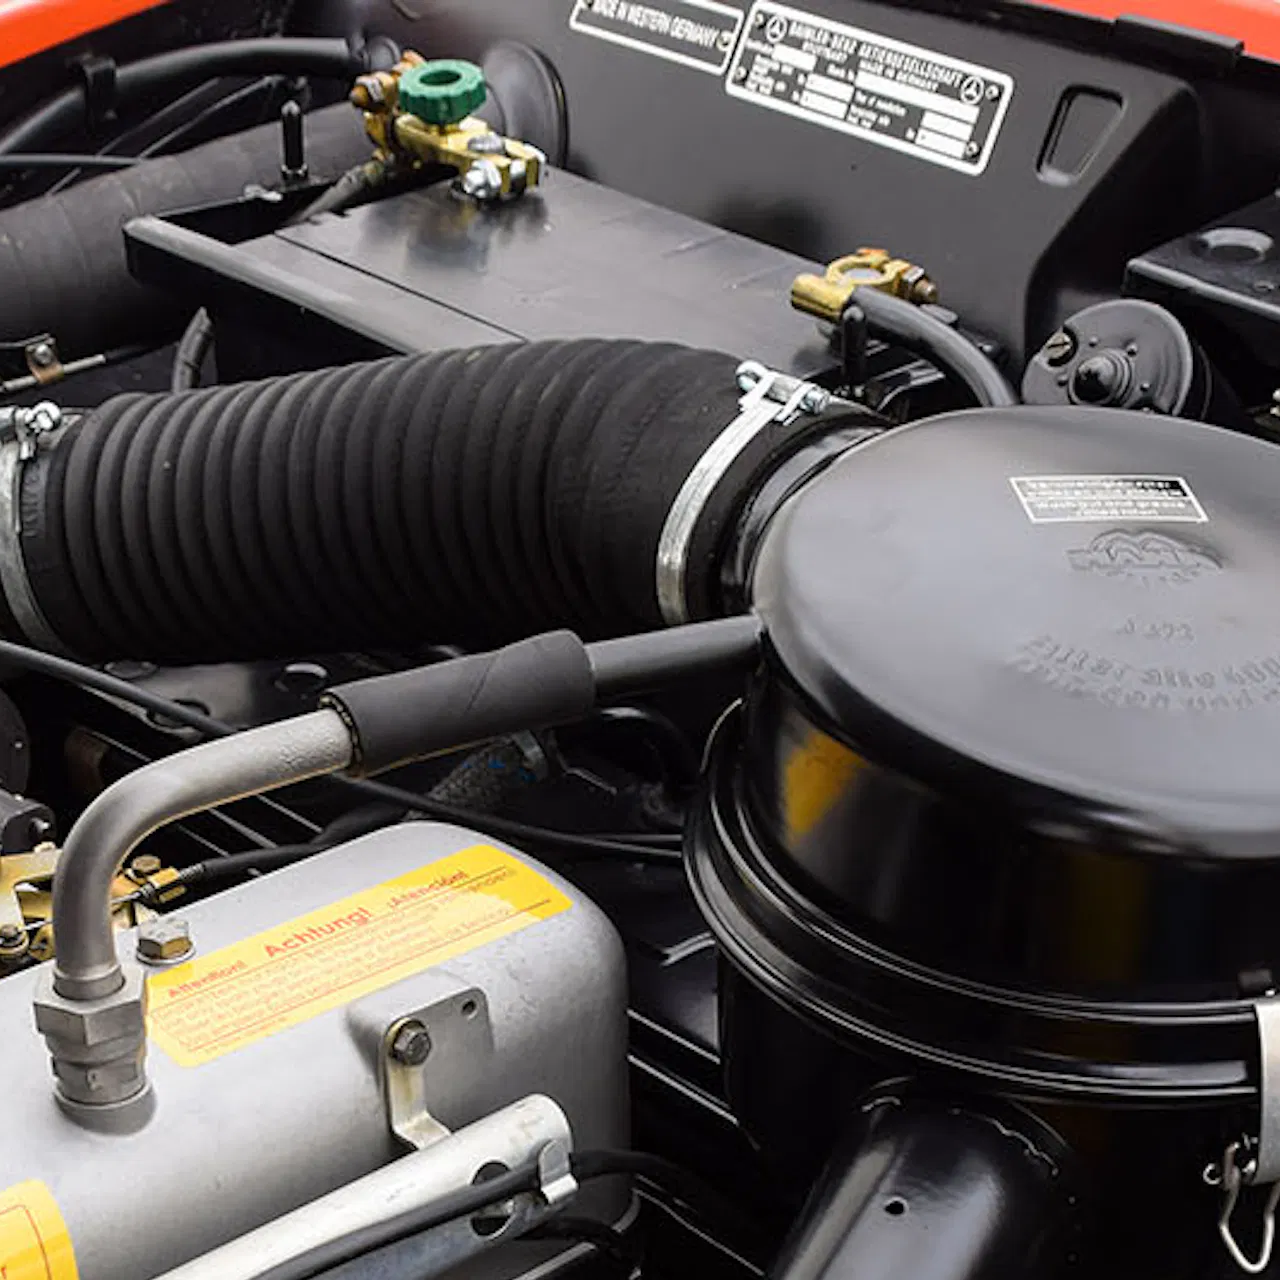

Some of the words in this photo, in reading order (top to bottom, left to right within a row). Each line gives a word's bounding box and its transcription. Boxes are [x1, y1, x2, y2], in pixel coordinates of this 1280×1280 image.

[627, 4, 670, 35] WESTERN
[670, 16, 719, 48] GERMANY
[263, 906, 371, 957] Achtung!
